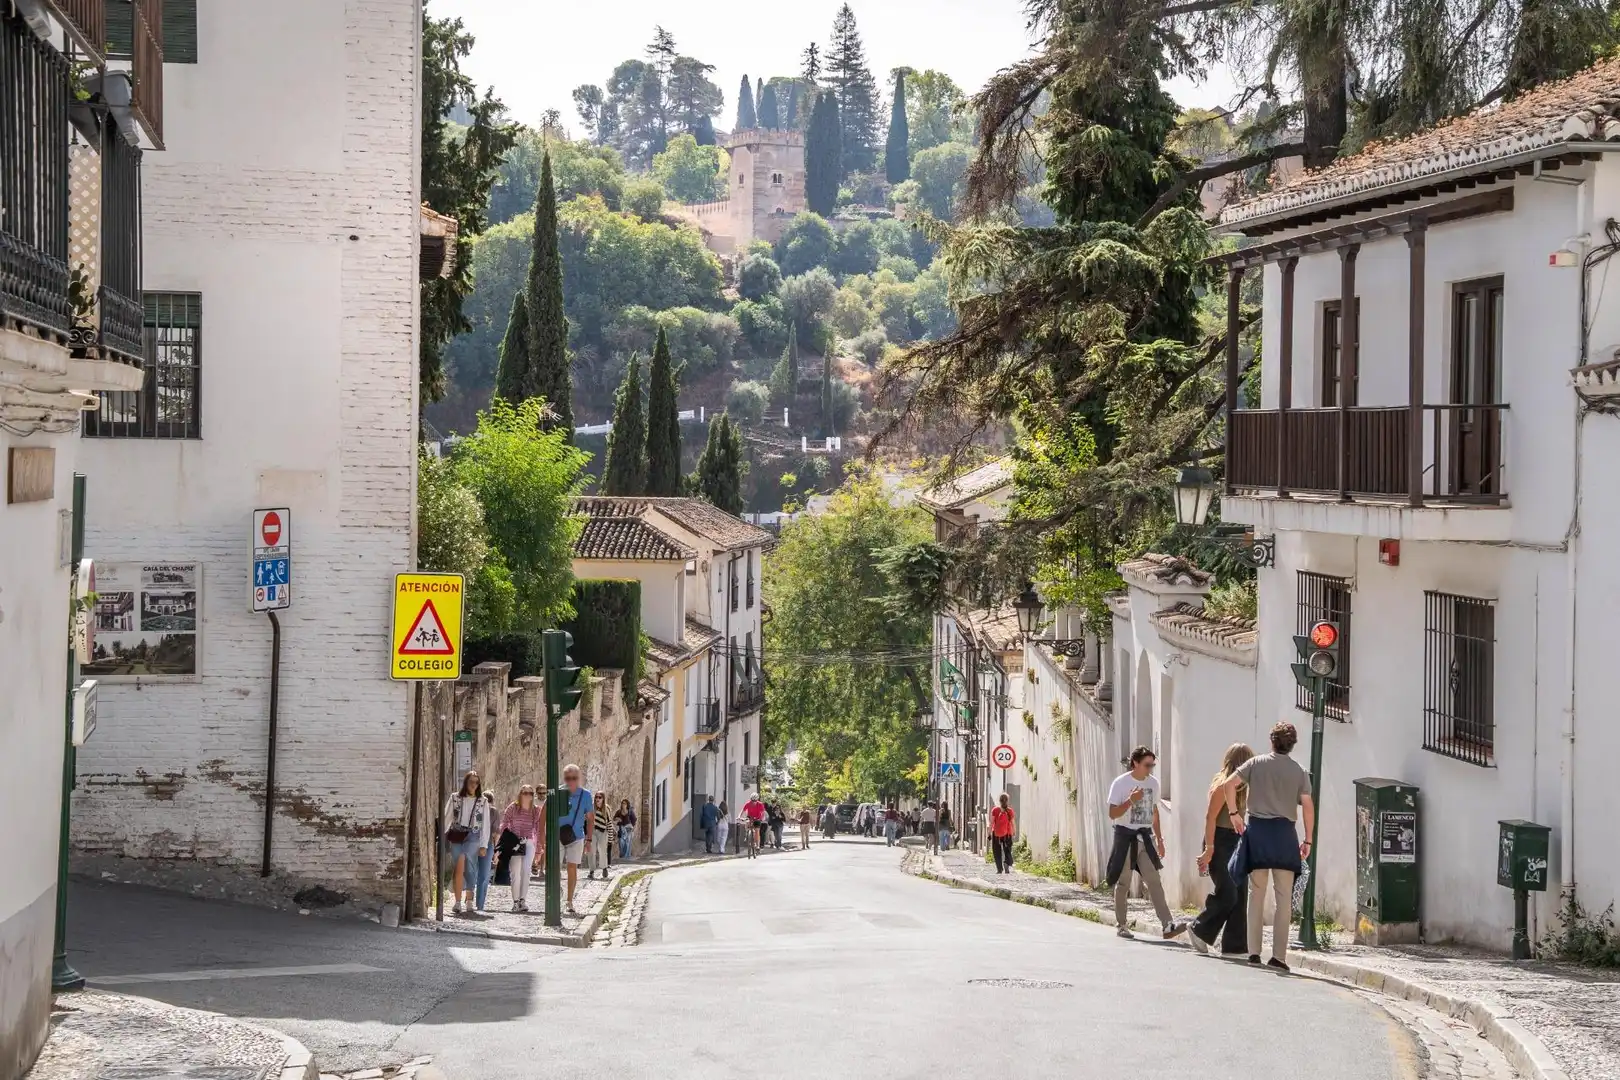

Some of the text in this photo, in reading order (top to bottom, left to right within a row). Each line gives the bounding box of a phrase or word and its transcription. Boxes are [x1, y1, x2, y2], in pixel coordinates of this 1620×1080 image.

[400, 581, 460, 592] ATENCIÓN
[398, 660, 453, 670] COLEGIO
[998, 752, 1011, 760] 20
